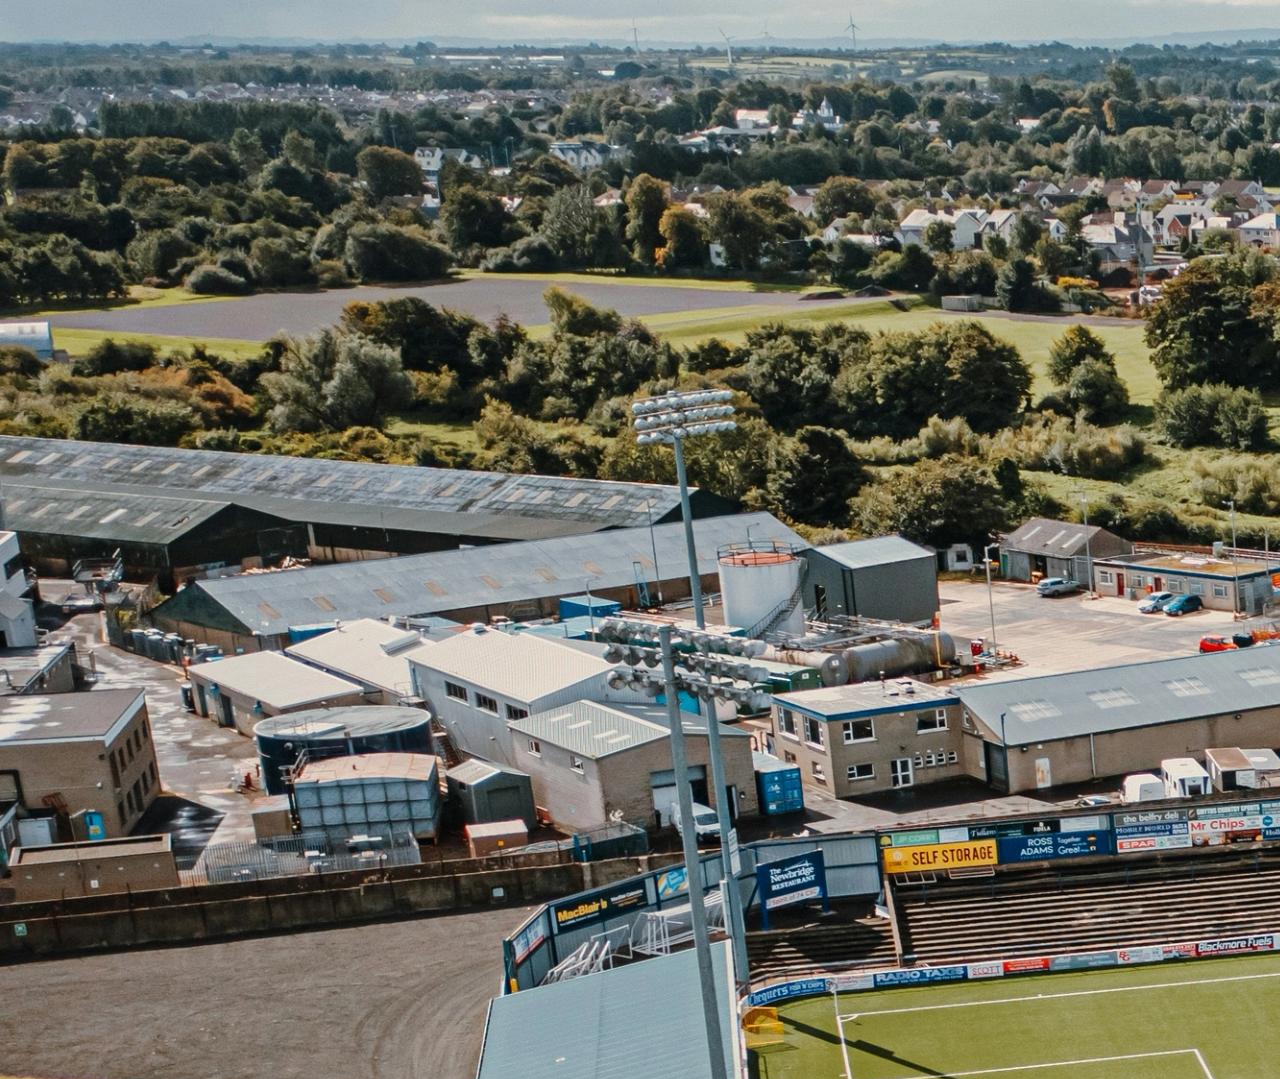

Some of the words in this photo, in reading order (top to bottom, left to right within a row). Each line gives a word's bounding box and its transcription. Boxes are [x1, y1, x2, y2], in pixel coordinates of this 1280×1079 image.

[1191, 822, 1206, 831] Mr
[1210, 818, 1245, 831] Chips
[1027, 837, 1053, 847] ROSS
[1122, 840, 1156, 849] SPAR
[912, 850, 939, 867] SELF
[942, 846, 994, 865] STORAGE
[1020, 845, 1054, 857] ADAMS
[769, 868, 781, 876] The
[769, 866, 815, 884] Newbridge
[771, 874, 816, 892] RESTAURANT
[557, 903, 600, 923] MacBlair
[1197, 940, 1246, 953] Blackmore
[1247, 937, 1273, 949] Fuels
[877, 969, 919, 982] RADIO
[924, 966, 965, 978] TAXIS
[972, 965, 1001, 977] SCOTT
